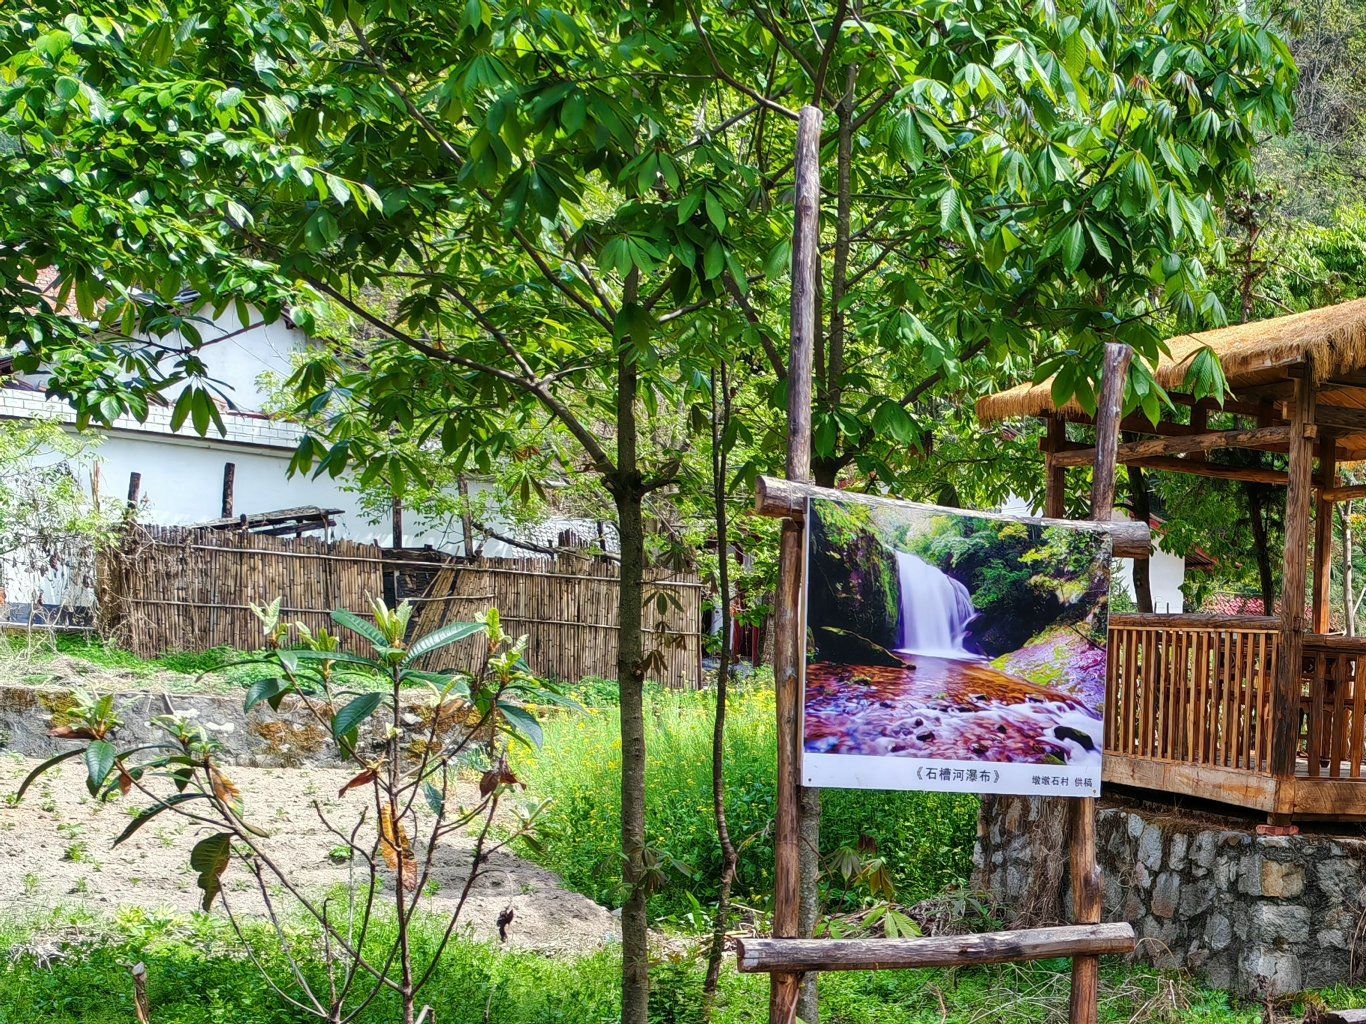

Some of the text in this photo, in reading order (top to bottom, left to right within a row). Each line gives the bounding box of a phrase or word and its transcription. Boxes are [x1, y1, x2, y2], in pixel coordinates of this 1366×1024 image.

[915, 765, 1000, 784] 《石槽河瀑布》
